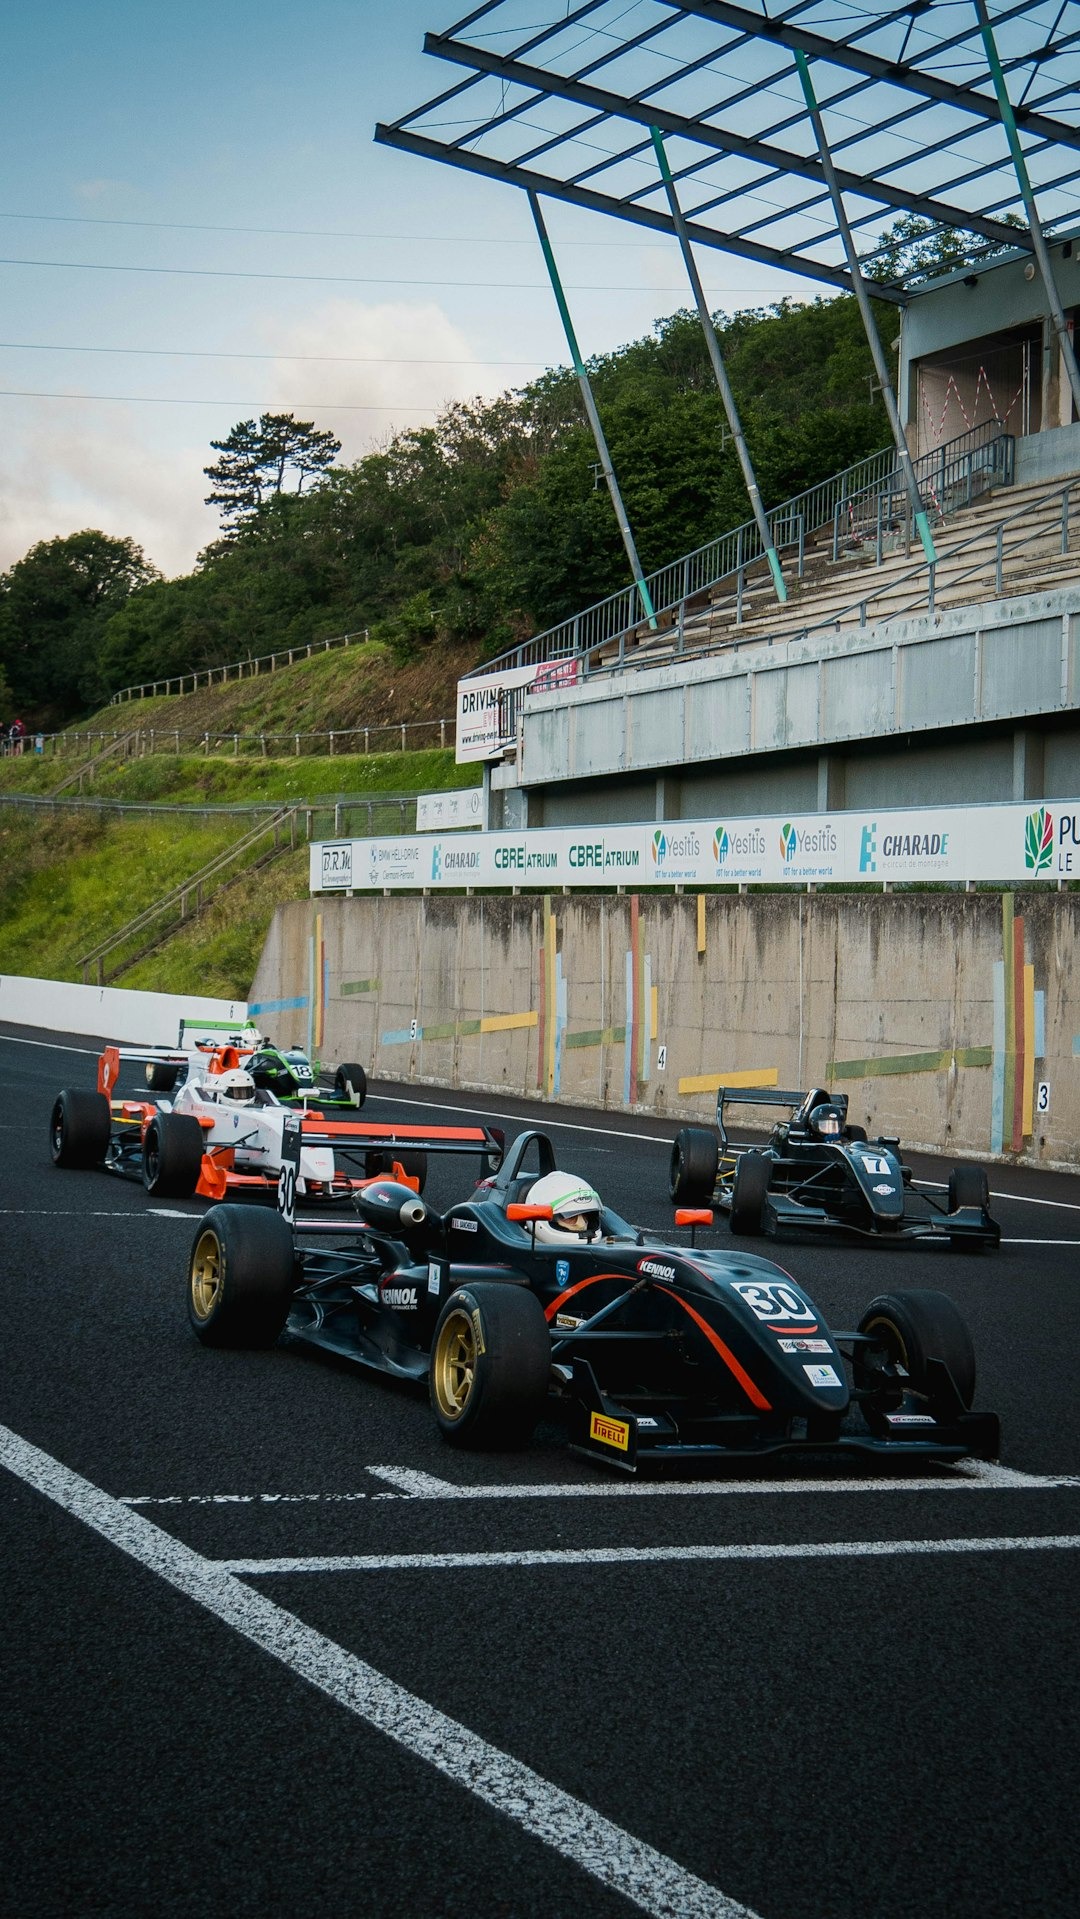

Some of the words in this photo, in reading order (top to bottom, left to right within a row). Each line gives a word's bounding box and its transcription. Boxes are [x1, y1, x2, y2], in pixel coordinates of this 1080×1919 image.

[666, 833, 700, 857] Yesitis
[728, 831, 766, 855] Yesitis
[796, 827, 837, 853] Yesitis
[882, 833, 950, 857] CHARADE
[444, 852, 481, 869] CHARADE
[494, 846, 525, 869] CBRE
[526, 852, 558, 869] ATRIUM
[568, 844, 603, 868] CBRE
[604, 850, 640, 867] ATRIUM
[1058, 852, 1073, 872] LE
[684, 870, 697, 878] world
[748, 868, 762, 877] world
[802, 867, 818, 876] better
[818, 866, 833, 876] world
[229, 1005, 234, 1019] 6
[410, 1022, 416, 1039] 5
[658, 1049, 666, 1068] 4
[103, 1062, 110, 1089] 9
[292, 1065, 312, 1077] 18
[1038, 1085, 1049, 1110] 3
[868, 1157, 881, 1172] 7
[277, 1165, 295, 1216] 30
[639, 1260, 676, 1279] KENNOL
[381, 1287, 418, 1305] KENNOL
[739, 1285, 808, 1316] 30
[593, 1417, 626, 1445] PIRELLI
